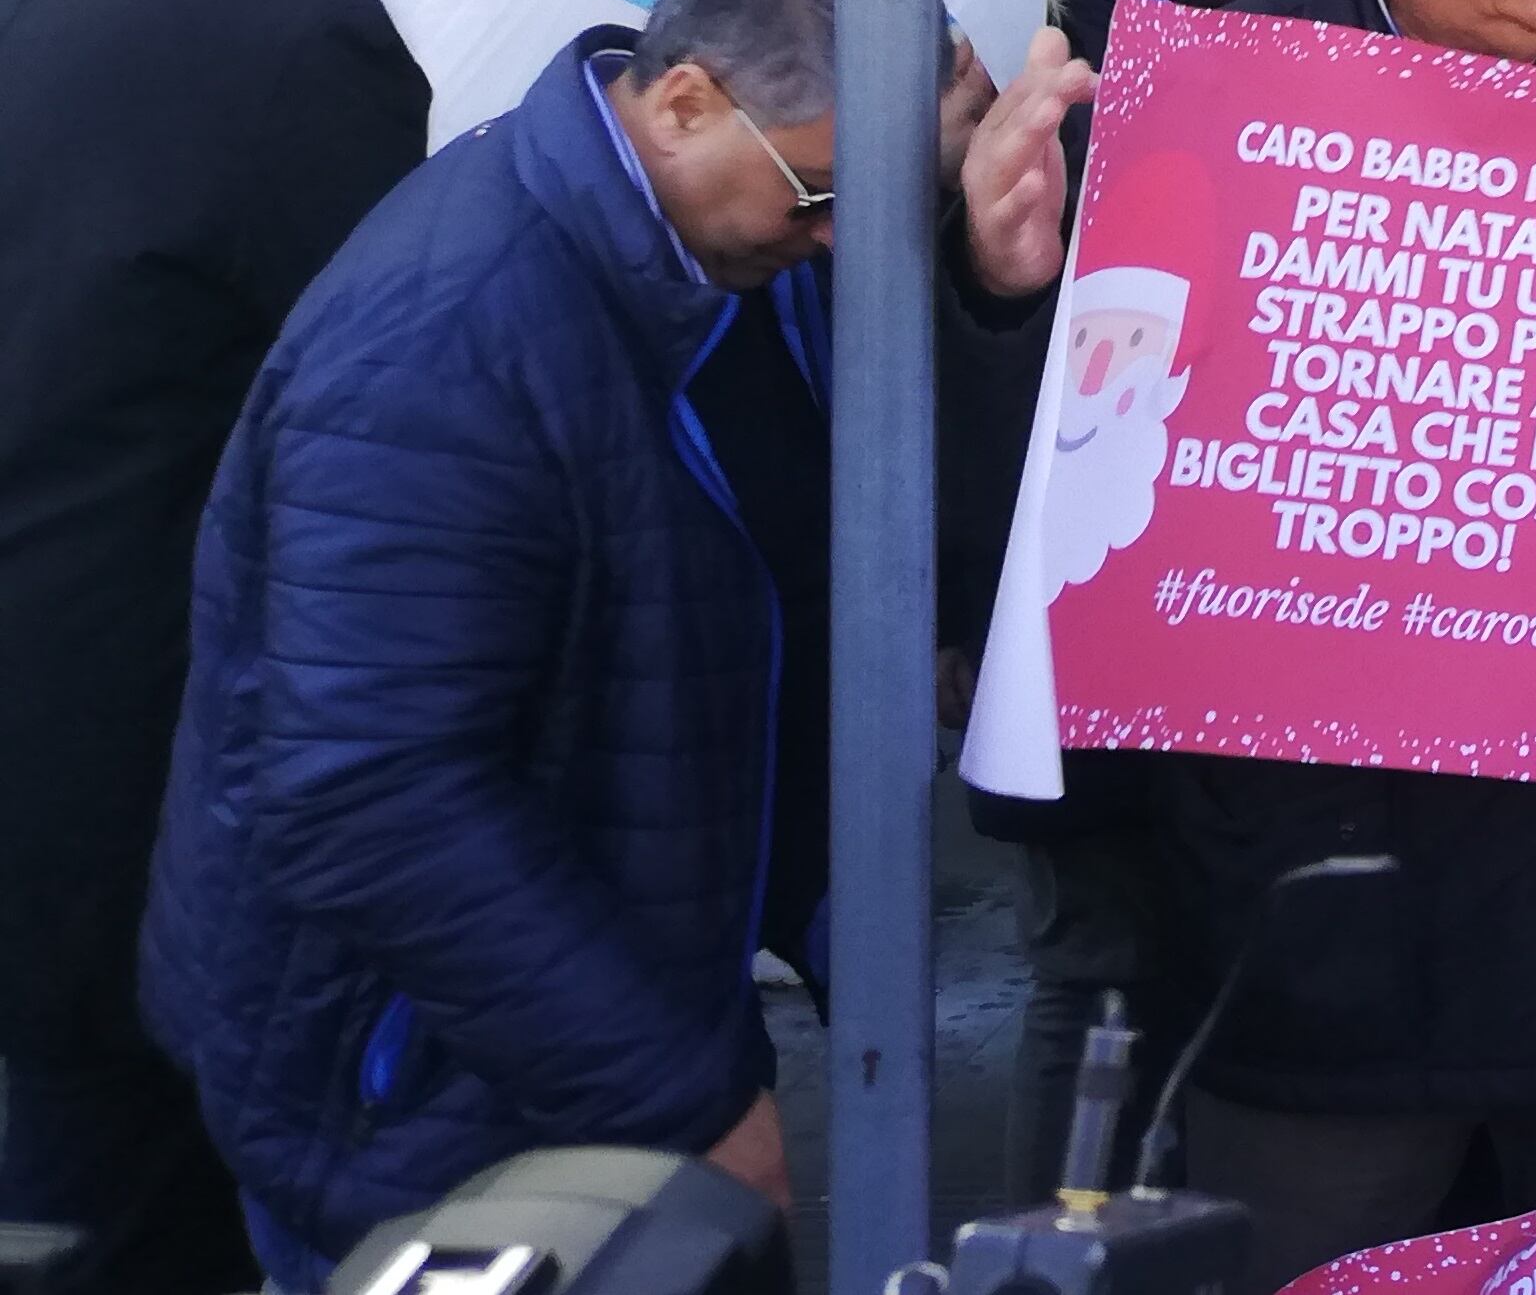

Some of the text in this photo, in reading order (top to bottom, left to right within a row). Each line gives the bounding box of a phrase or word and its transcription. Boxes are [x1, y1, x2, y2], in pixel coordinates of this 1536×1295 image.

[1236, 121, 1354, 175] CARO
[1361, 141, 1517, 198] BABBO
[1292, 186, 1390, 243] PER
[1239, 232, 1424, 298] DAMMI
[1438, 255, 1507, 307] TU
[1247, 287, 1501, 361] STRAPPO
[1266, 341, 1522, 416] TORNARE
[1245, 392, 1398, 457] CASA
[1410, 412, 1519, 469] CHE
[1170, 437, 1442, 512] BIGLIETTO
[1271, 499, 1515, 574] TROPPO!
[1153, 568, 1391, 632] #fuorisede
